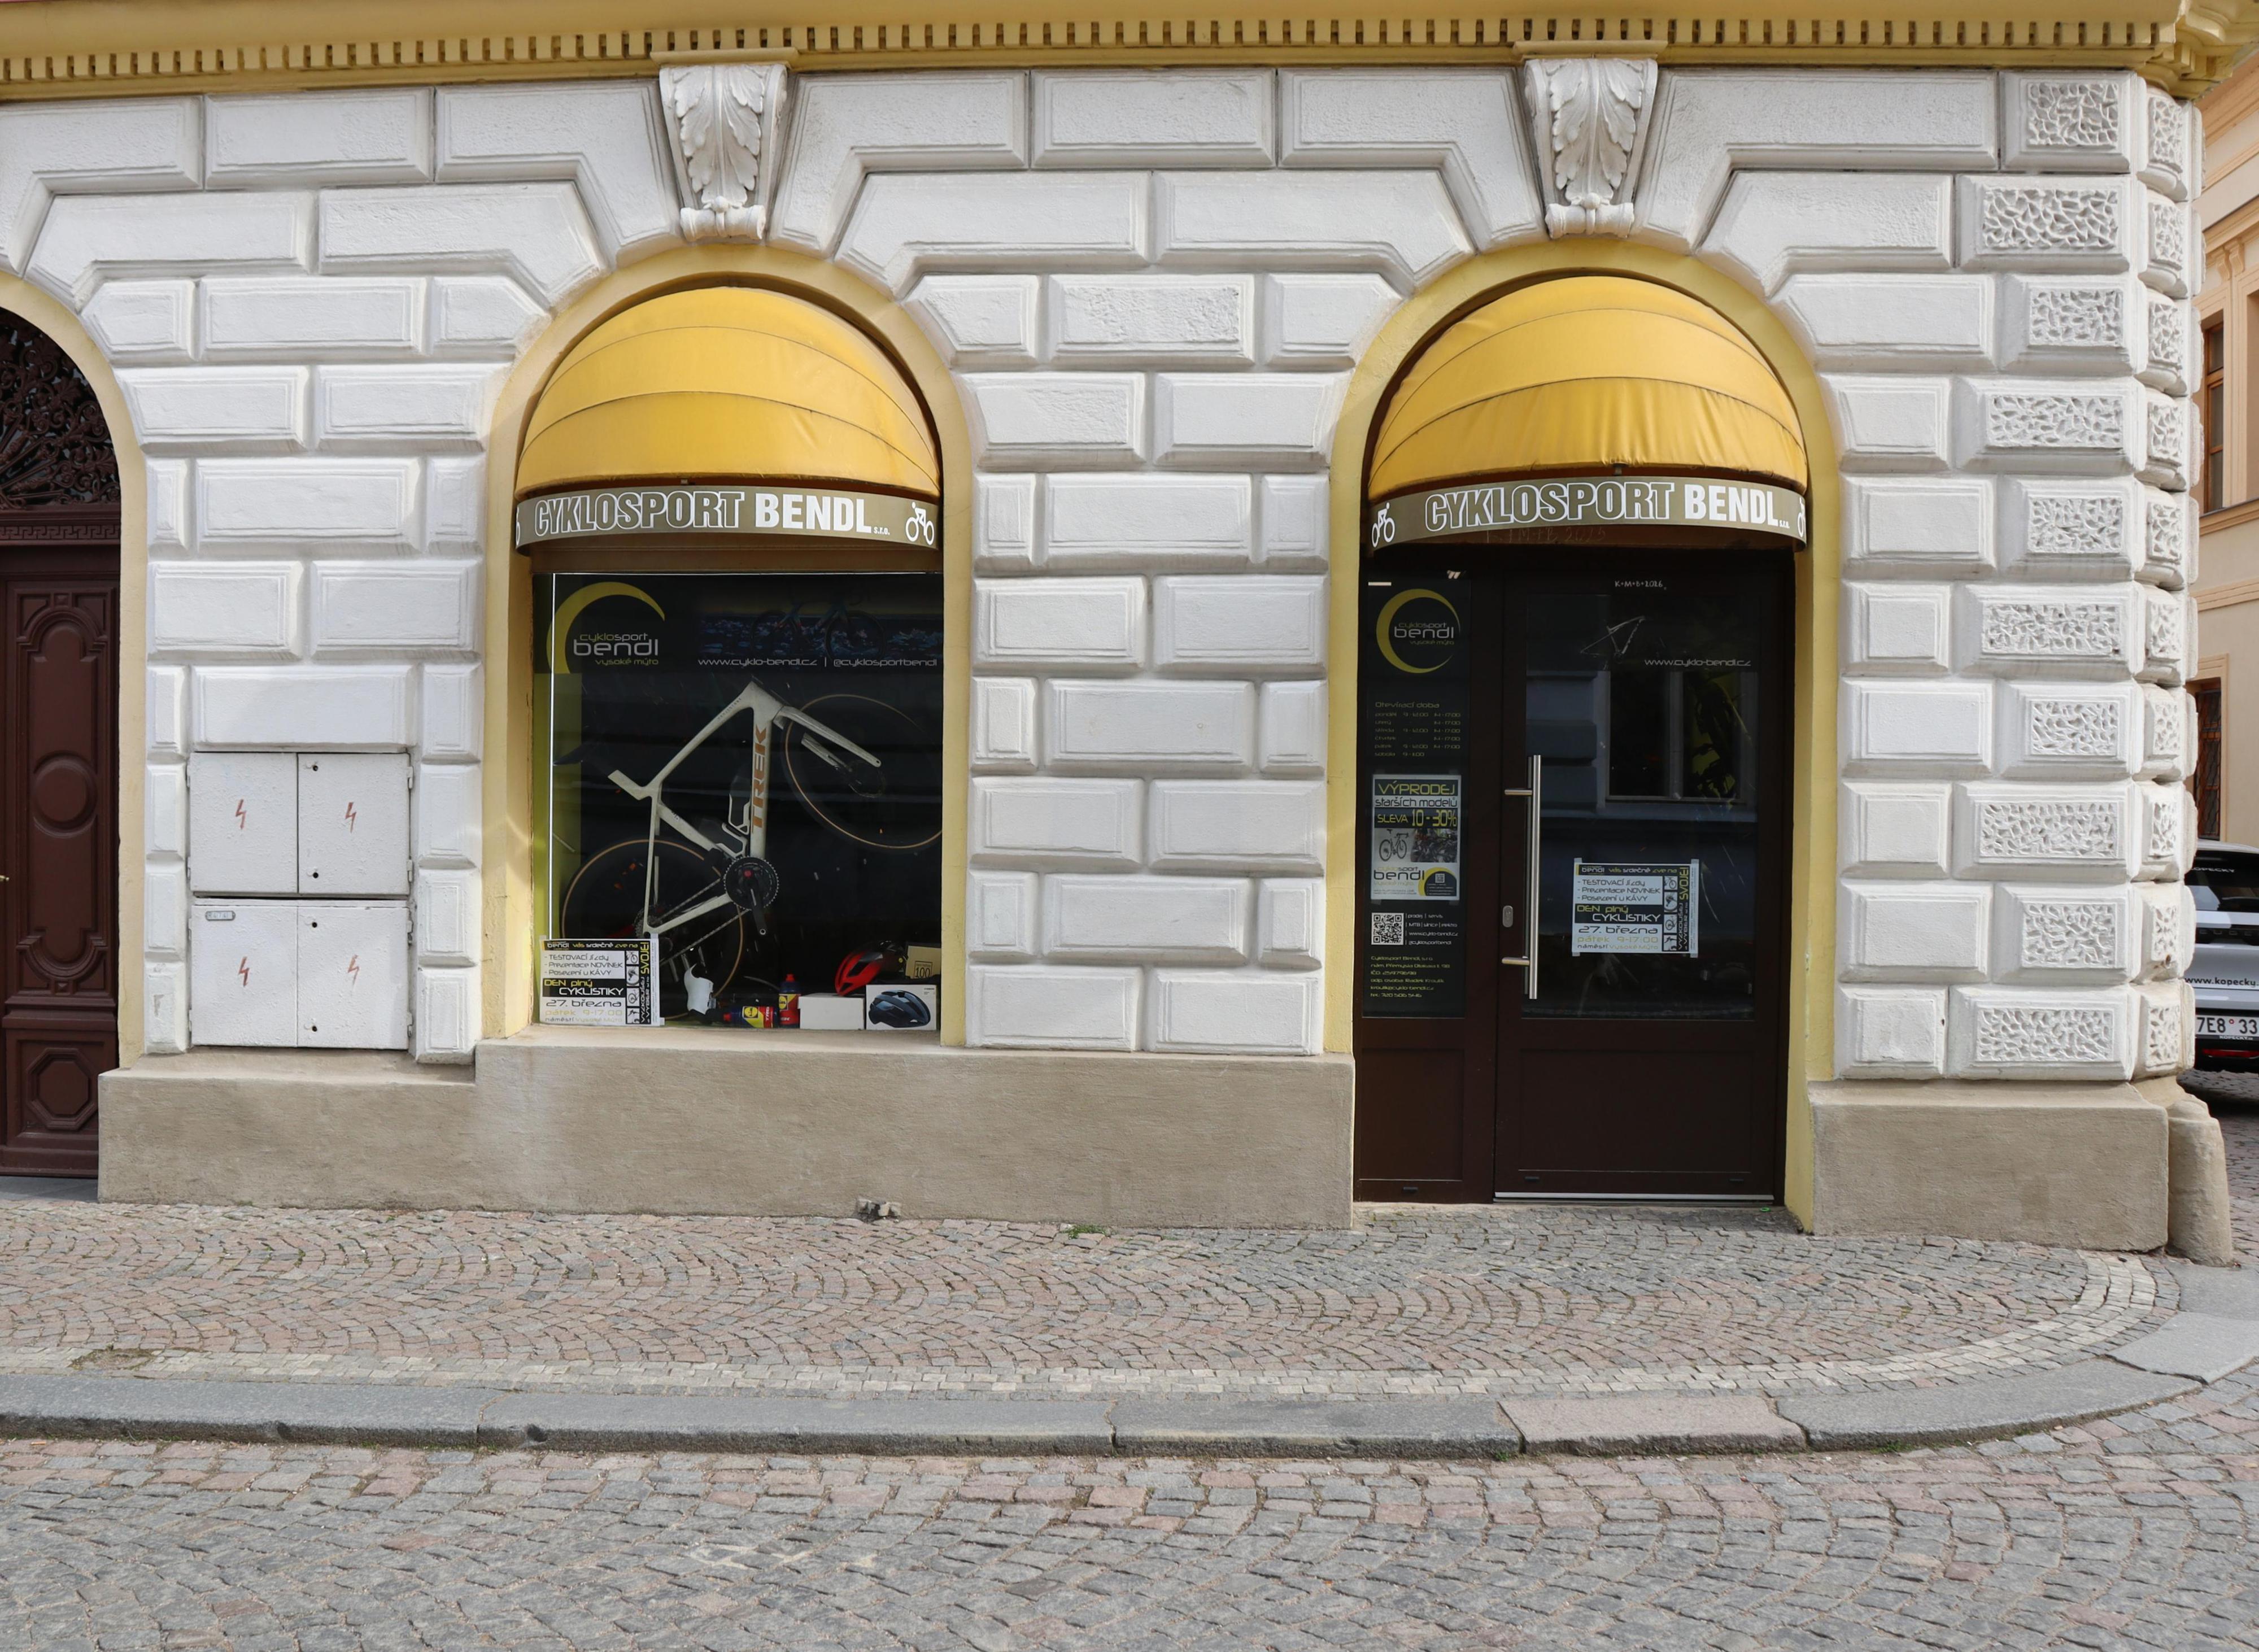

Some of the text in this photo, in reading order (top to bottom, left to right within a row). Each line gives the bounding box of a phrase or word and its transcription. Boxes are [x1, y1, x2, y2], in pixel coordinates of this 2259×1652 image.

[1425, 481, 1790, 531] CYKLOSPORT BENDL s.r.o.
[535, 491, 890, 537] CYKLOSPORT BENDL s.r.o.
[579, 631, 648, 643] cyklosport
[1394, 626, 1454, 639] bendl
[574, 639, 658, 656] bendl
[595, 657, 658, 666] vysoké mýto
[698, 657, 817, 667] www.cyklo-bendl.cz
[834, 657, 937, 668] @cyklosportbendl
[751, 725, 767, 834] TREK
[1378, 781, 1455, 795] VÝPRODEJ
[1375, 797, 1457, 807] starších modelů
[1377, 814, 1408, 823] SLEVA
[1412, 809, 1424, 826] 10
[1432, 809, 1457, 827] 30%
[1373, 870, 1424, 881] bendl
[1593, 913, 1661, 922] CYKLISTIKY
[915, 967, 931, 978] 100
[570, 979, 593, 988] plný
[559, 987, 624, 996] CYKLISTIKY
[2196, 1017, 2258, 1034] 7E8 33
